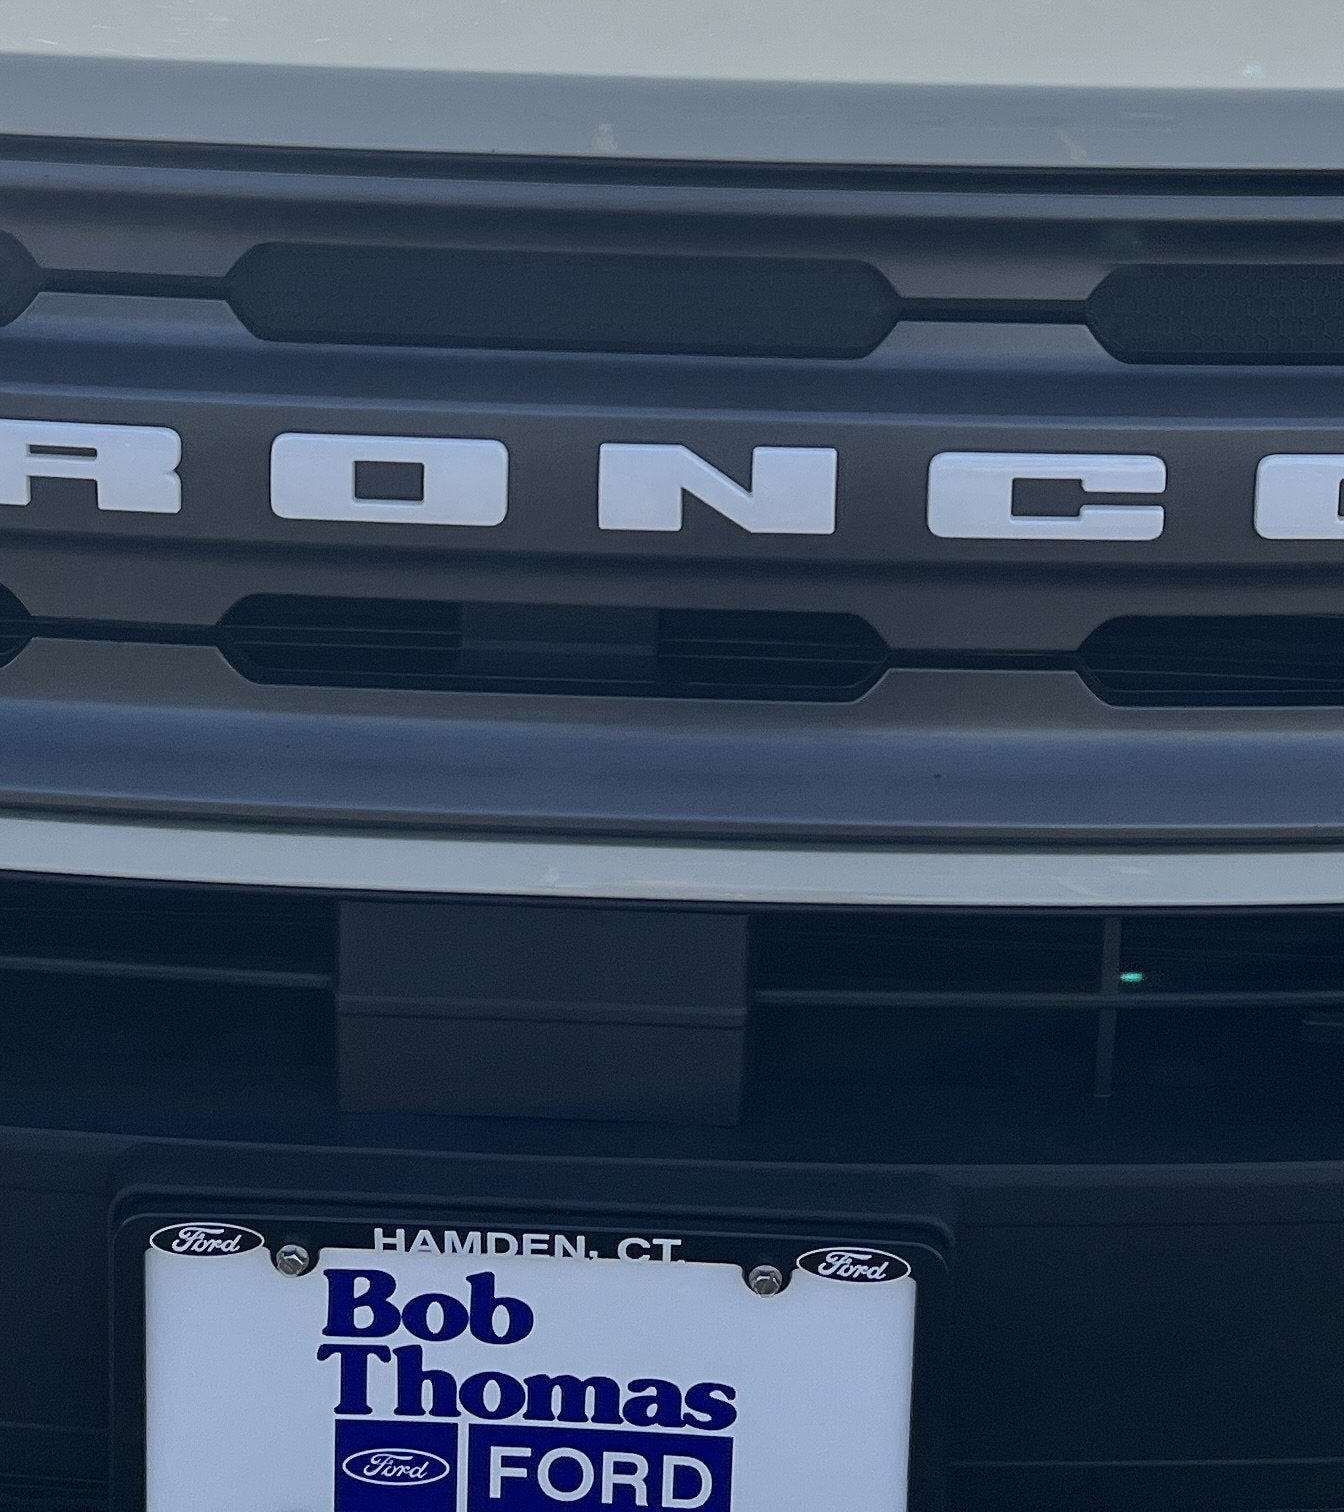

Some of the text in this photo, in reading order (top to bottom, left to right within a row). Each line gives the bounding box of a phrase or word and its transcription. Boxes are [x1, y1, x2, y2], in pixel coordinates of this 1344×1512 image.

[171, 1226, 242, 1253] Ford
[373, 1227, 598, 1260] HAMDEN,
[817, 1251, 889, 1280] Ford
[322, 1268, 534, 1345] Bob
[316, 1343, 737, 1431] Thomas
[362, 1445, 714, 1509] Ford FORD
